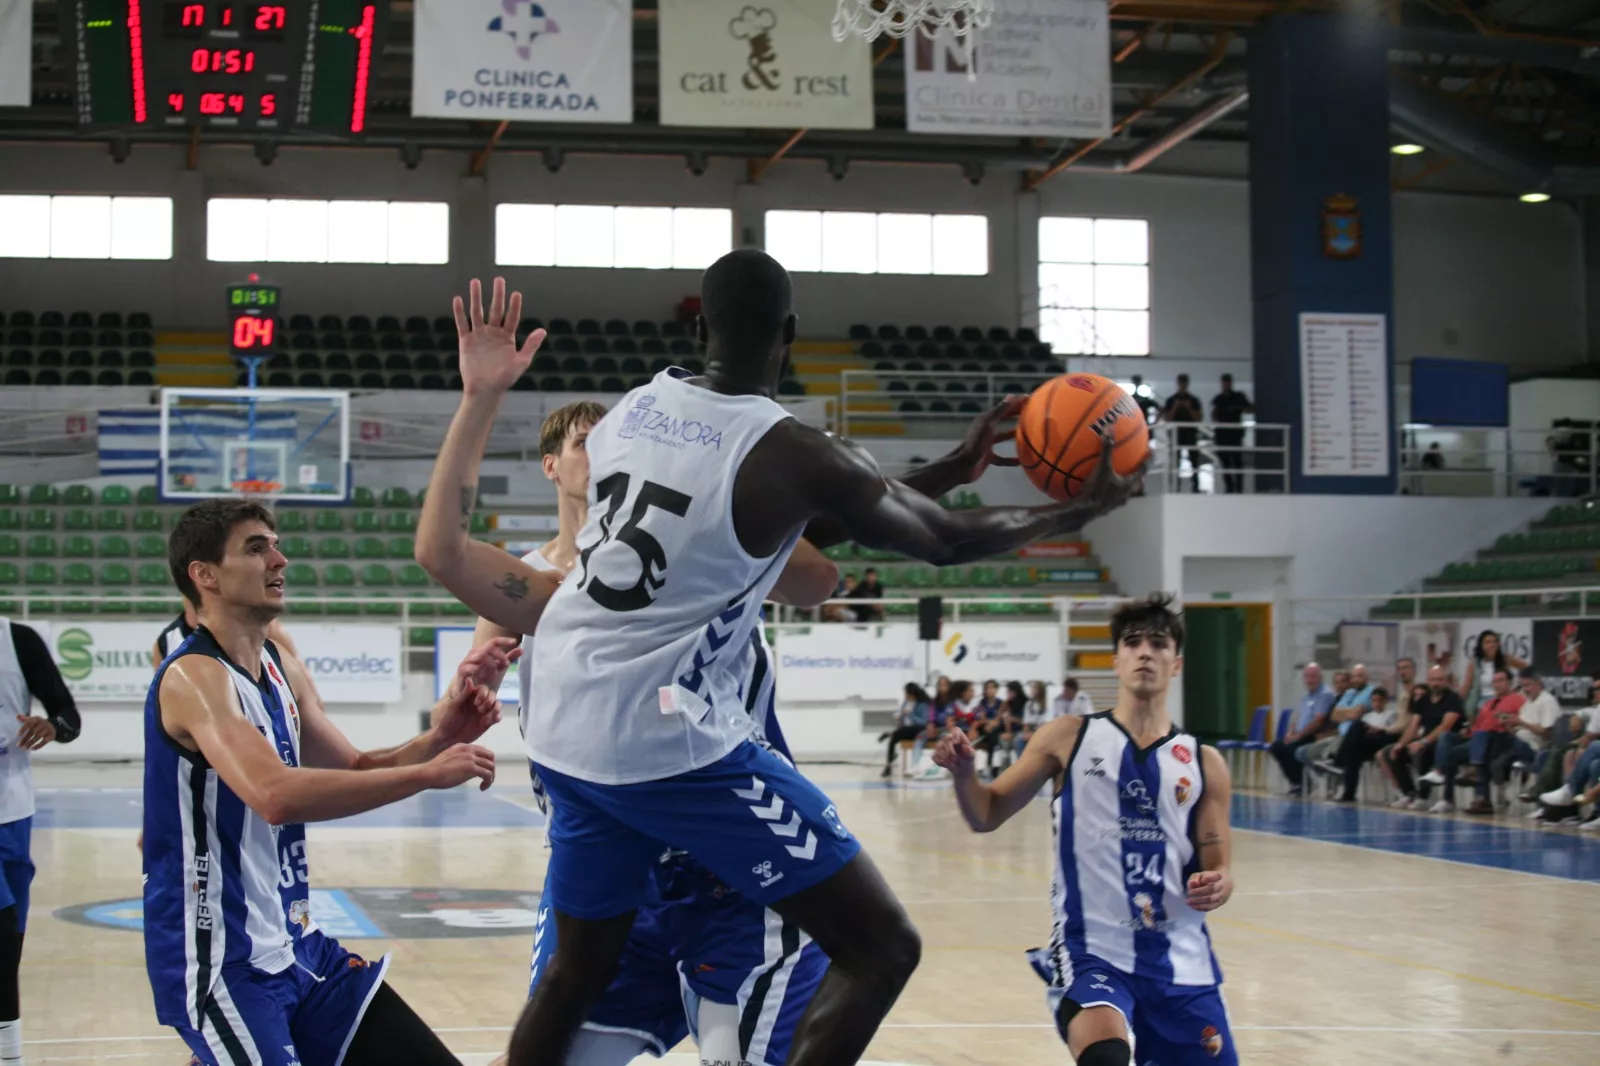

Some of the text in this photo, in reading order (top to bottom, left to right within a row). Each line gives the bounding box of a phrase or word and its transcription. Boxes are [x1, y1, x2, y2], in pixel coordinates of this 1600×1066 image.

[255, 6, 286, 30] 27
[680, 71, 729, 93] cat
[793, 74, 851, 97] rest
[168, 93, 184, 112] 4
[260, 94, 276, 115] 5
[445, 89, 600, 111] PONFERRADA
[233, 316, 274, 349] 04
[643, 410, 723, 451] ZAMORA
[304, 652, 394, 674] novelec
[1126, 852, 1163, 886] 24
